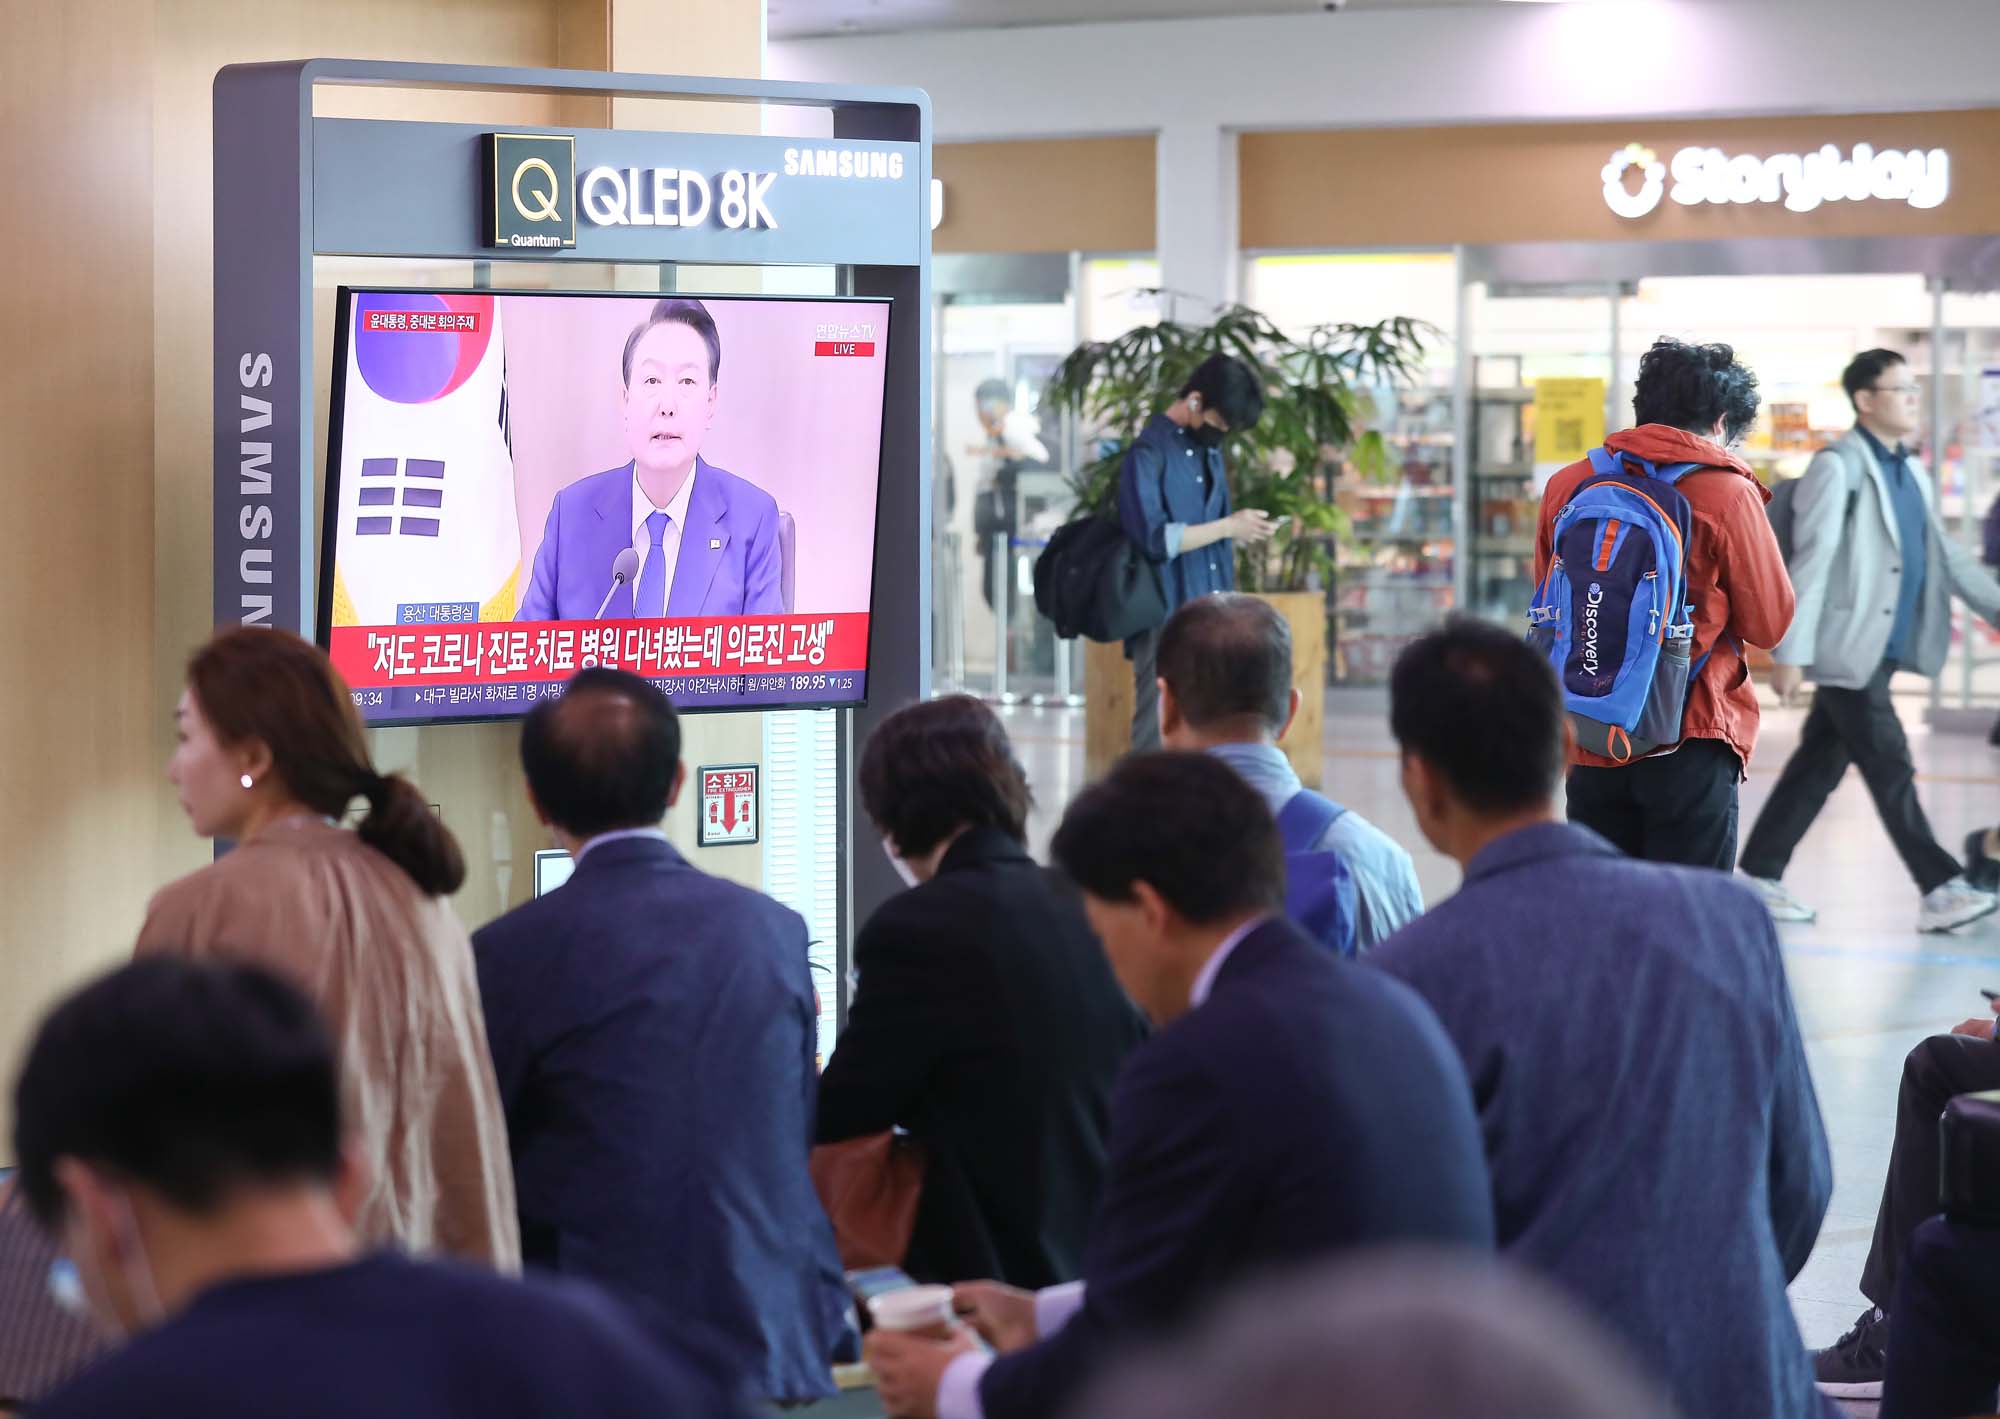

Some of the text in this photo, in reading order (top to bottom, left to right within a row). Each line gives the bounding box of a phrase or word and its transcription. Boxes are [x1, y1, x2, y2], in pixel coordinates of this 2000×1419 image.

[784, 148, 903, 179] SAMSUNG
[511, 157, 562, 222] Q
[582, 165, 778, 230] QLED 8K
[511, 233, 561, 248] Quantum
[370, 313, 475, 331] 윤대통령, 중대본 회의 주재
[816, 323, 876, 339] 연합뉴스TV
[833, 343, 856, 355] LIVE
[239, 352, 273, 630] SAMSUN
[403, 603, 474, 623] 용산 대통령실
[367, 619, 835, 680] "저도 코로나 진료·치료 병원 다녀봤는데 의료진 고생"
[790, 674, 826, 690] 189.95
[836, 678, 853, 689] 1.25
[423, 687, 447, 705] 대구
[449, 686, 482, 704] 빌라서
[484, 684, 519, 702] 화재로
[521, 684, 537, 701] 1명
[707, 773, 752, 788] 소화기
